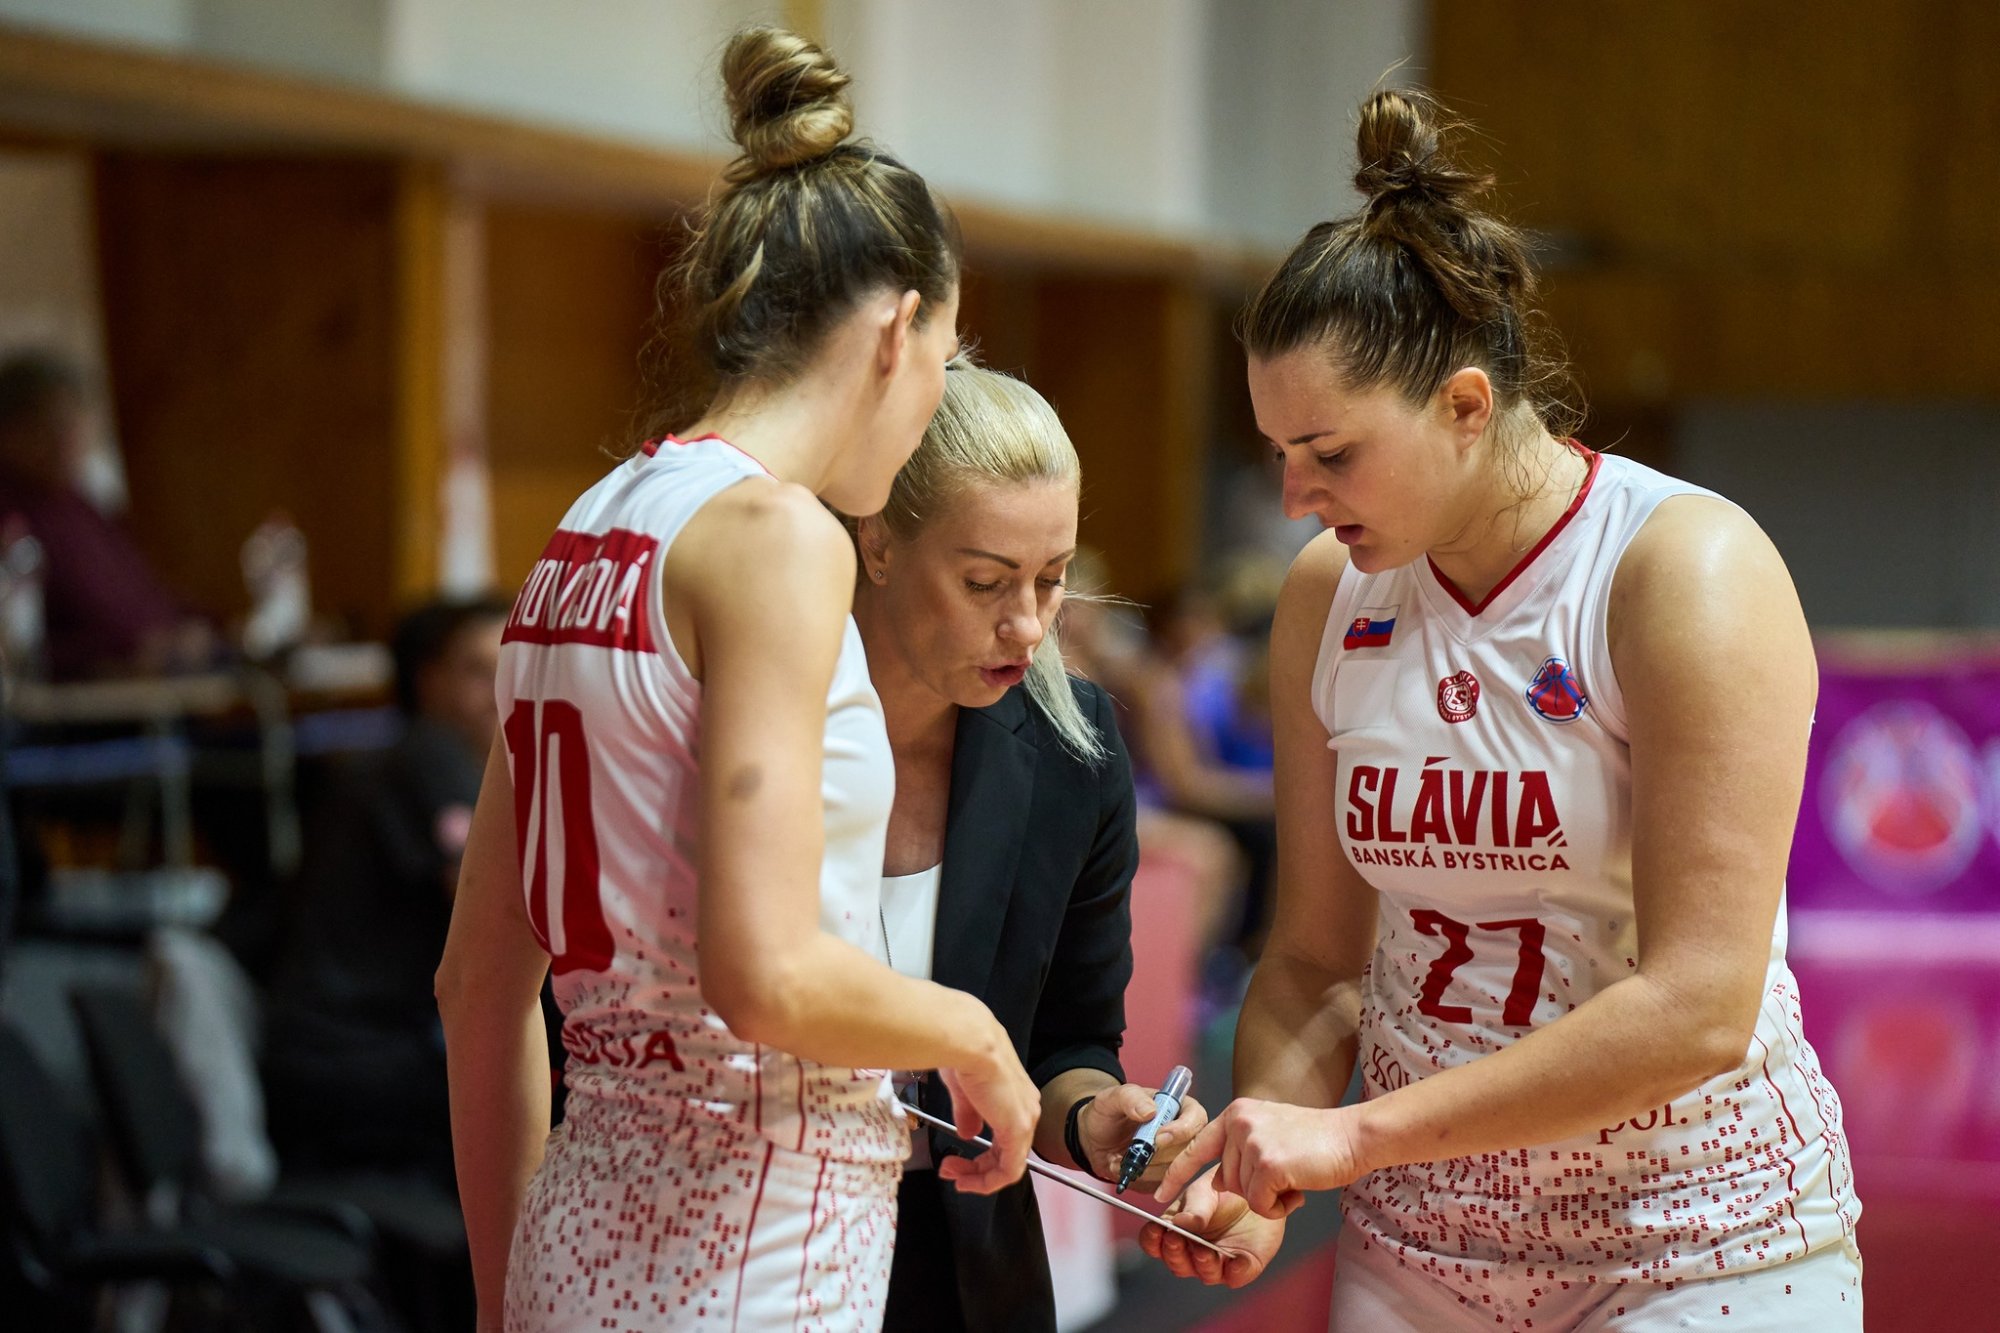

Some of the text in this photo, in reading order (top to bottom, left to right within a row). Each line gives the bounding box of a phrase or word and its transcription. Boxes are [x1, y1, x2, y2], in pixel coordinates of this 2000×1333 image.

[504, 699, 615, 975] 10
[1347, 756, 1568, 848] SLÁVIA
[1351, 846, 1570, 871] BANSKÁ BYSTRICA
[1409, 908, 1546, 1027] 27
